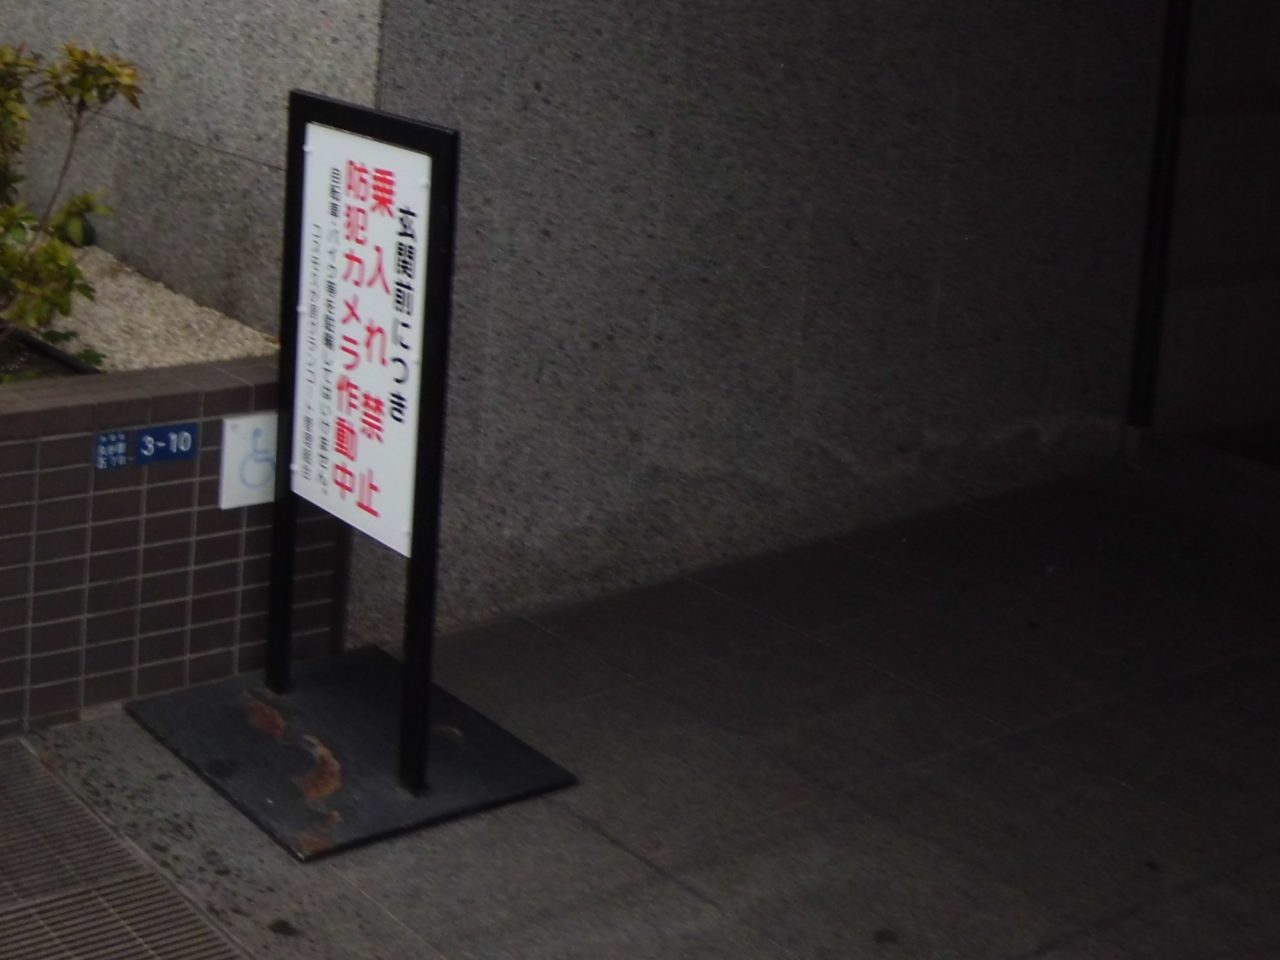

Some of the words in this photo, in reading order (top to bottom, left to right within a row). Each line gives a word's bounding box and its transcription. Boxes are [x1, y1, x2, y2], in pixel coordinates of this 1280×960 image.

[140, 431, 192, 456] 3-10
[333, 159, 370, 500] 防犯カメラ作動中
[356, 167, 396, 518] 乗入れ禁止
[389, 206, 418, 423] 玄関前につき
